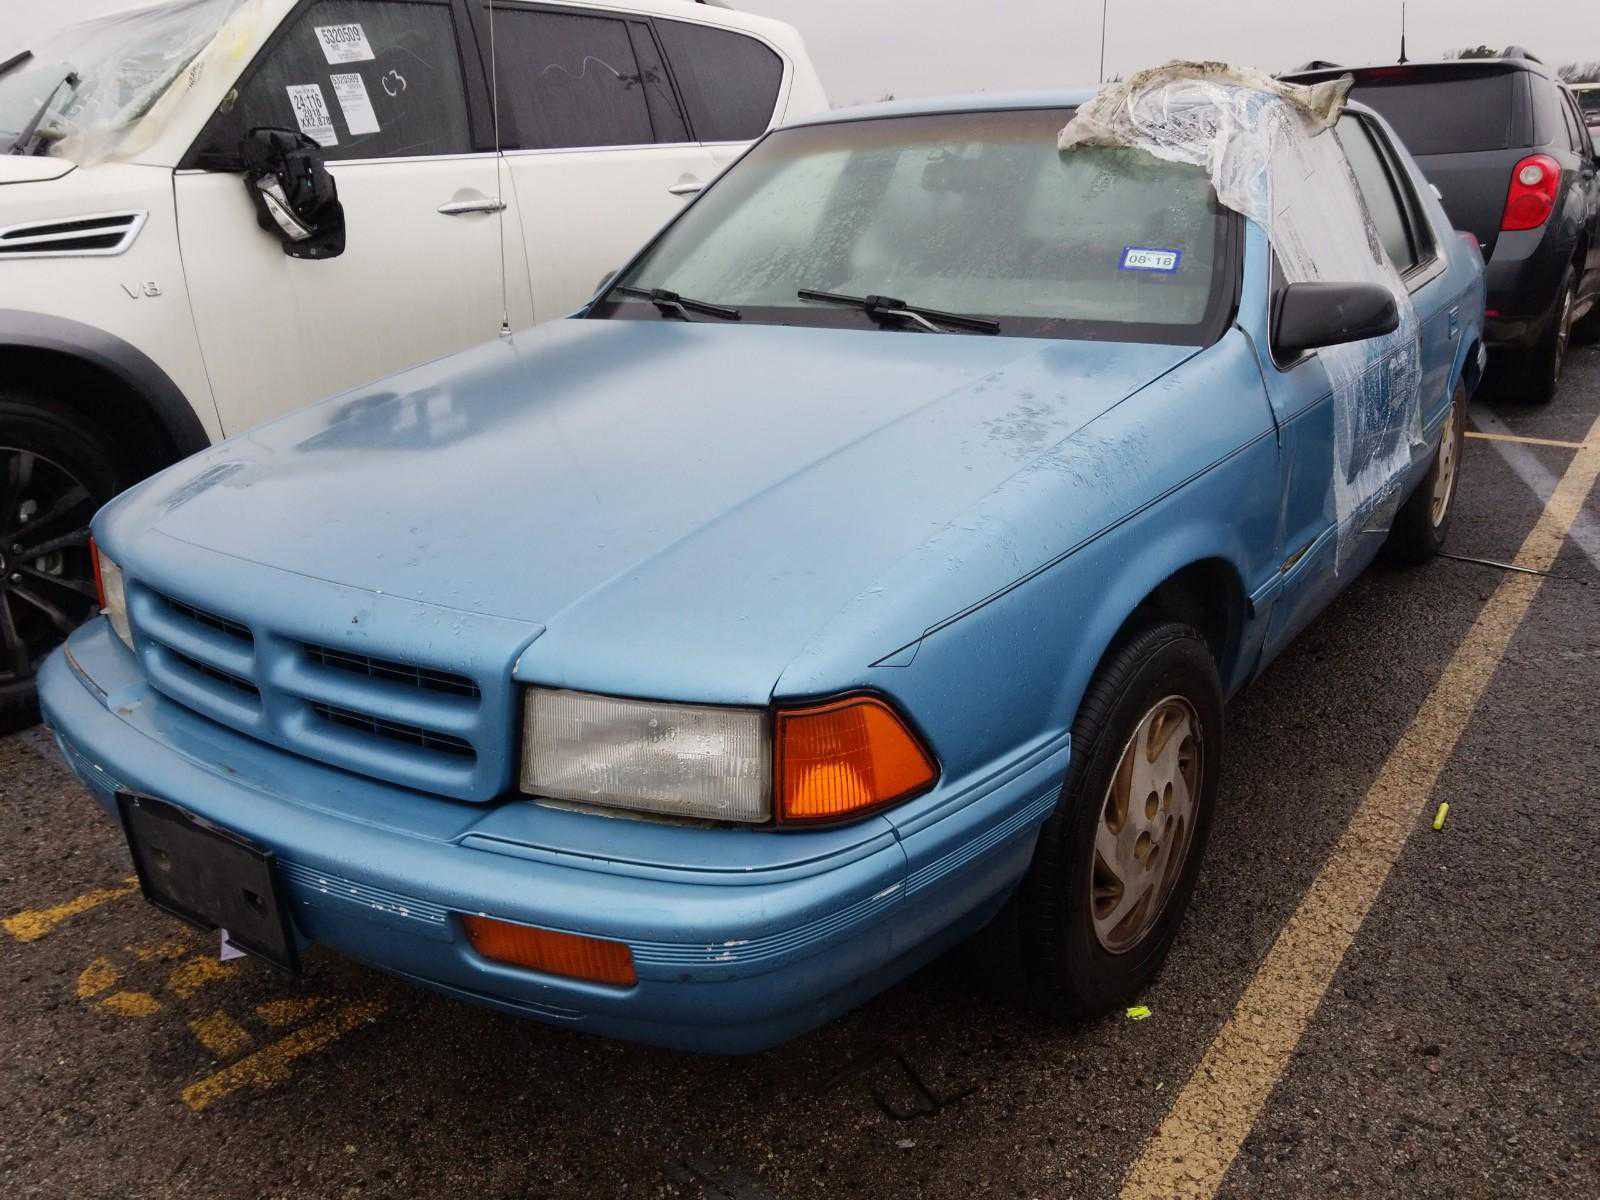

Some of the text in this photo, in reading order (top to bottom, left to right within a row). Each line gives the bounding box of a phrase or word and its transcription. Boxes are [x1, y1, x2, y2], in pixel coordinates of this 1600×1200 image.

[321, 26, 361, 44] 5320509
[1129, 254, 1146, 264] 08
[120, 281, 162, 300] V8
